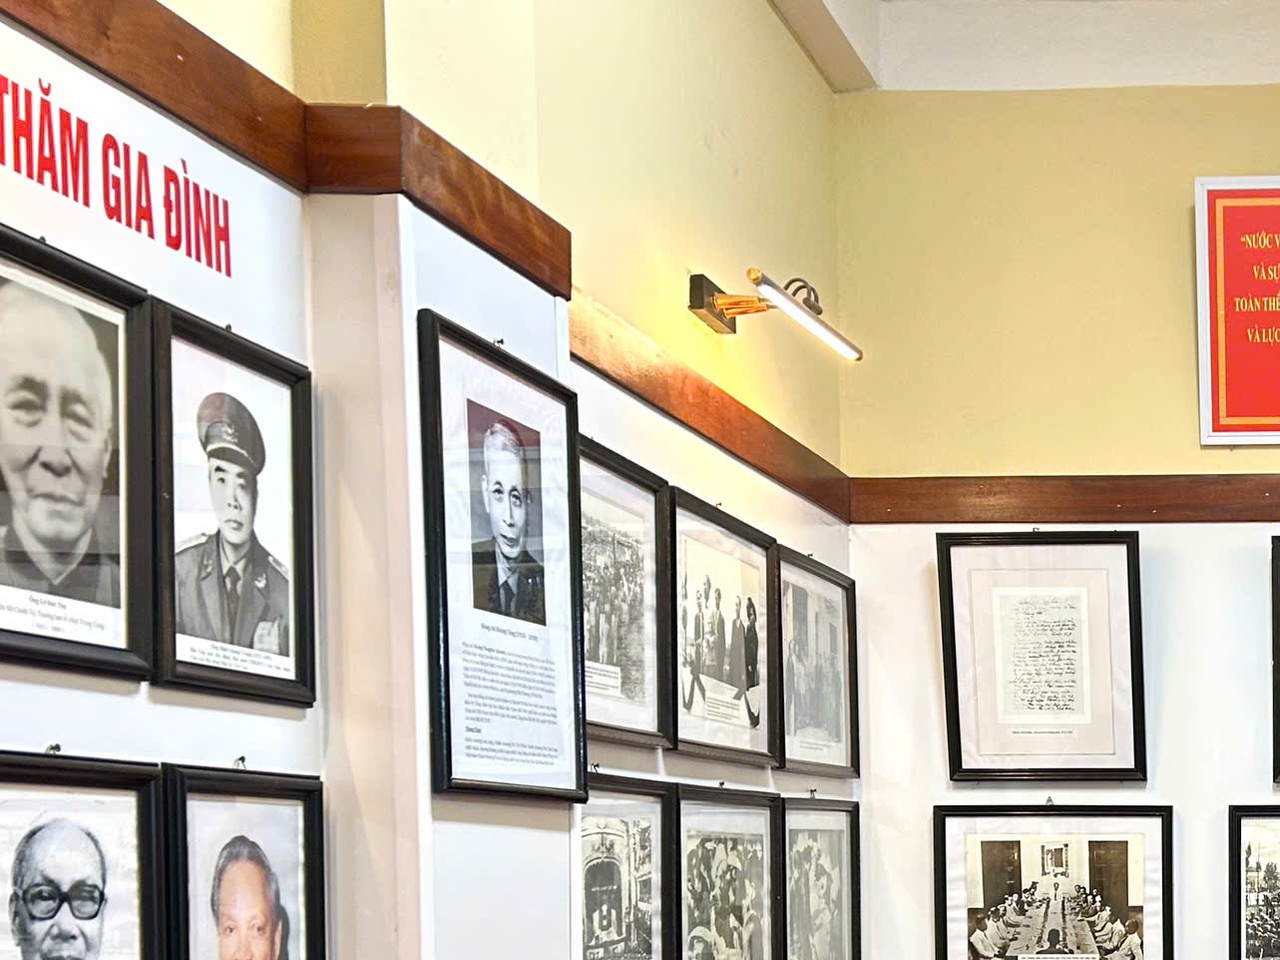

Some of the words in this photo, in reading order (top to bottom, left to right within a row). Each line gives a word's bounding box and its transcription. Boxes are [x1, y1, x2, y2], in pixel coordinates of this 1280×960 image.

[102, 133, 155, 240] GIA
[163, 158, 232, 278] ĐÌNH
[1253, 261, 1267, 280] VÀ
[1268, 263, 1280, 283] SỰ
[1234, 292, 1261, 312] TOÀN
[1247, 324, 1260, 343] VÀ
